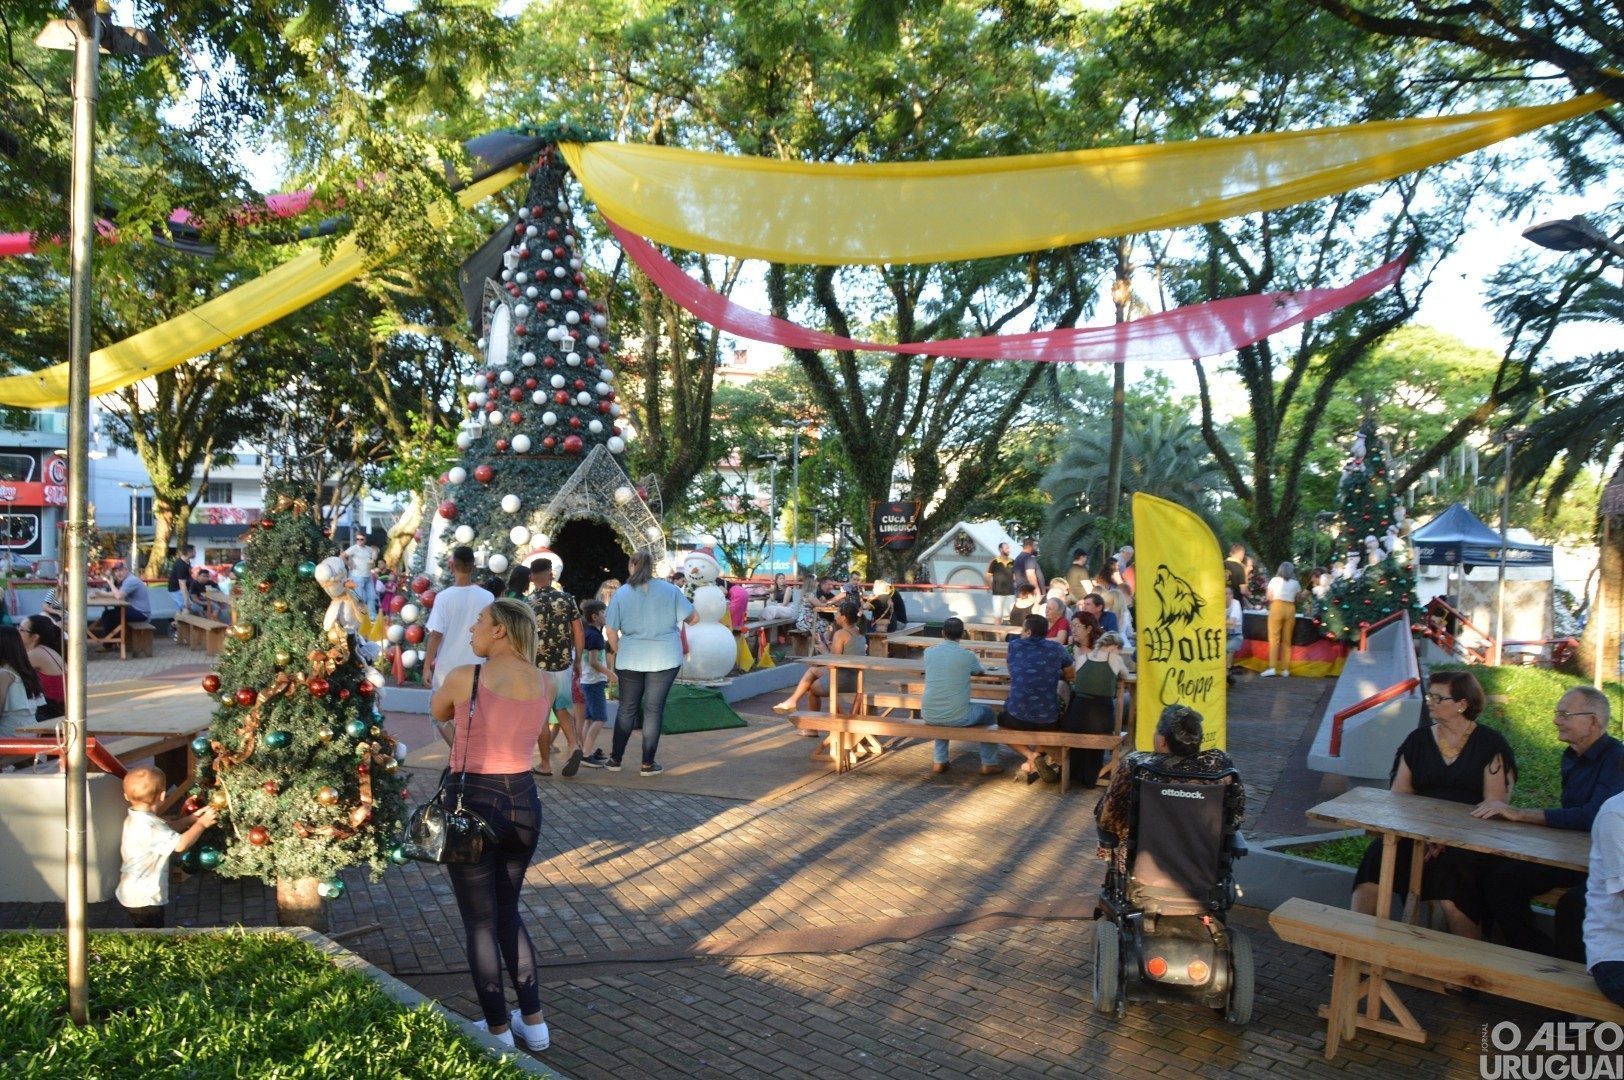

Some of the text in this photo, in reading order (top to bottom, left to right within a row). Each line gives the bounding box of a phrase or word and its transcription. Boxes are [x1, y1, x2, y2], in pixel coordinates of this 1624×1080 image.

[881, 515, 906, 523] CUCA
[1143, 626, 1222, 664] Wolff
[1159, 667, 1214, 706] Chopp
[1161, 788, 1205, 799] ottobock.
